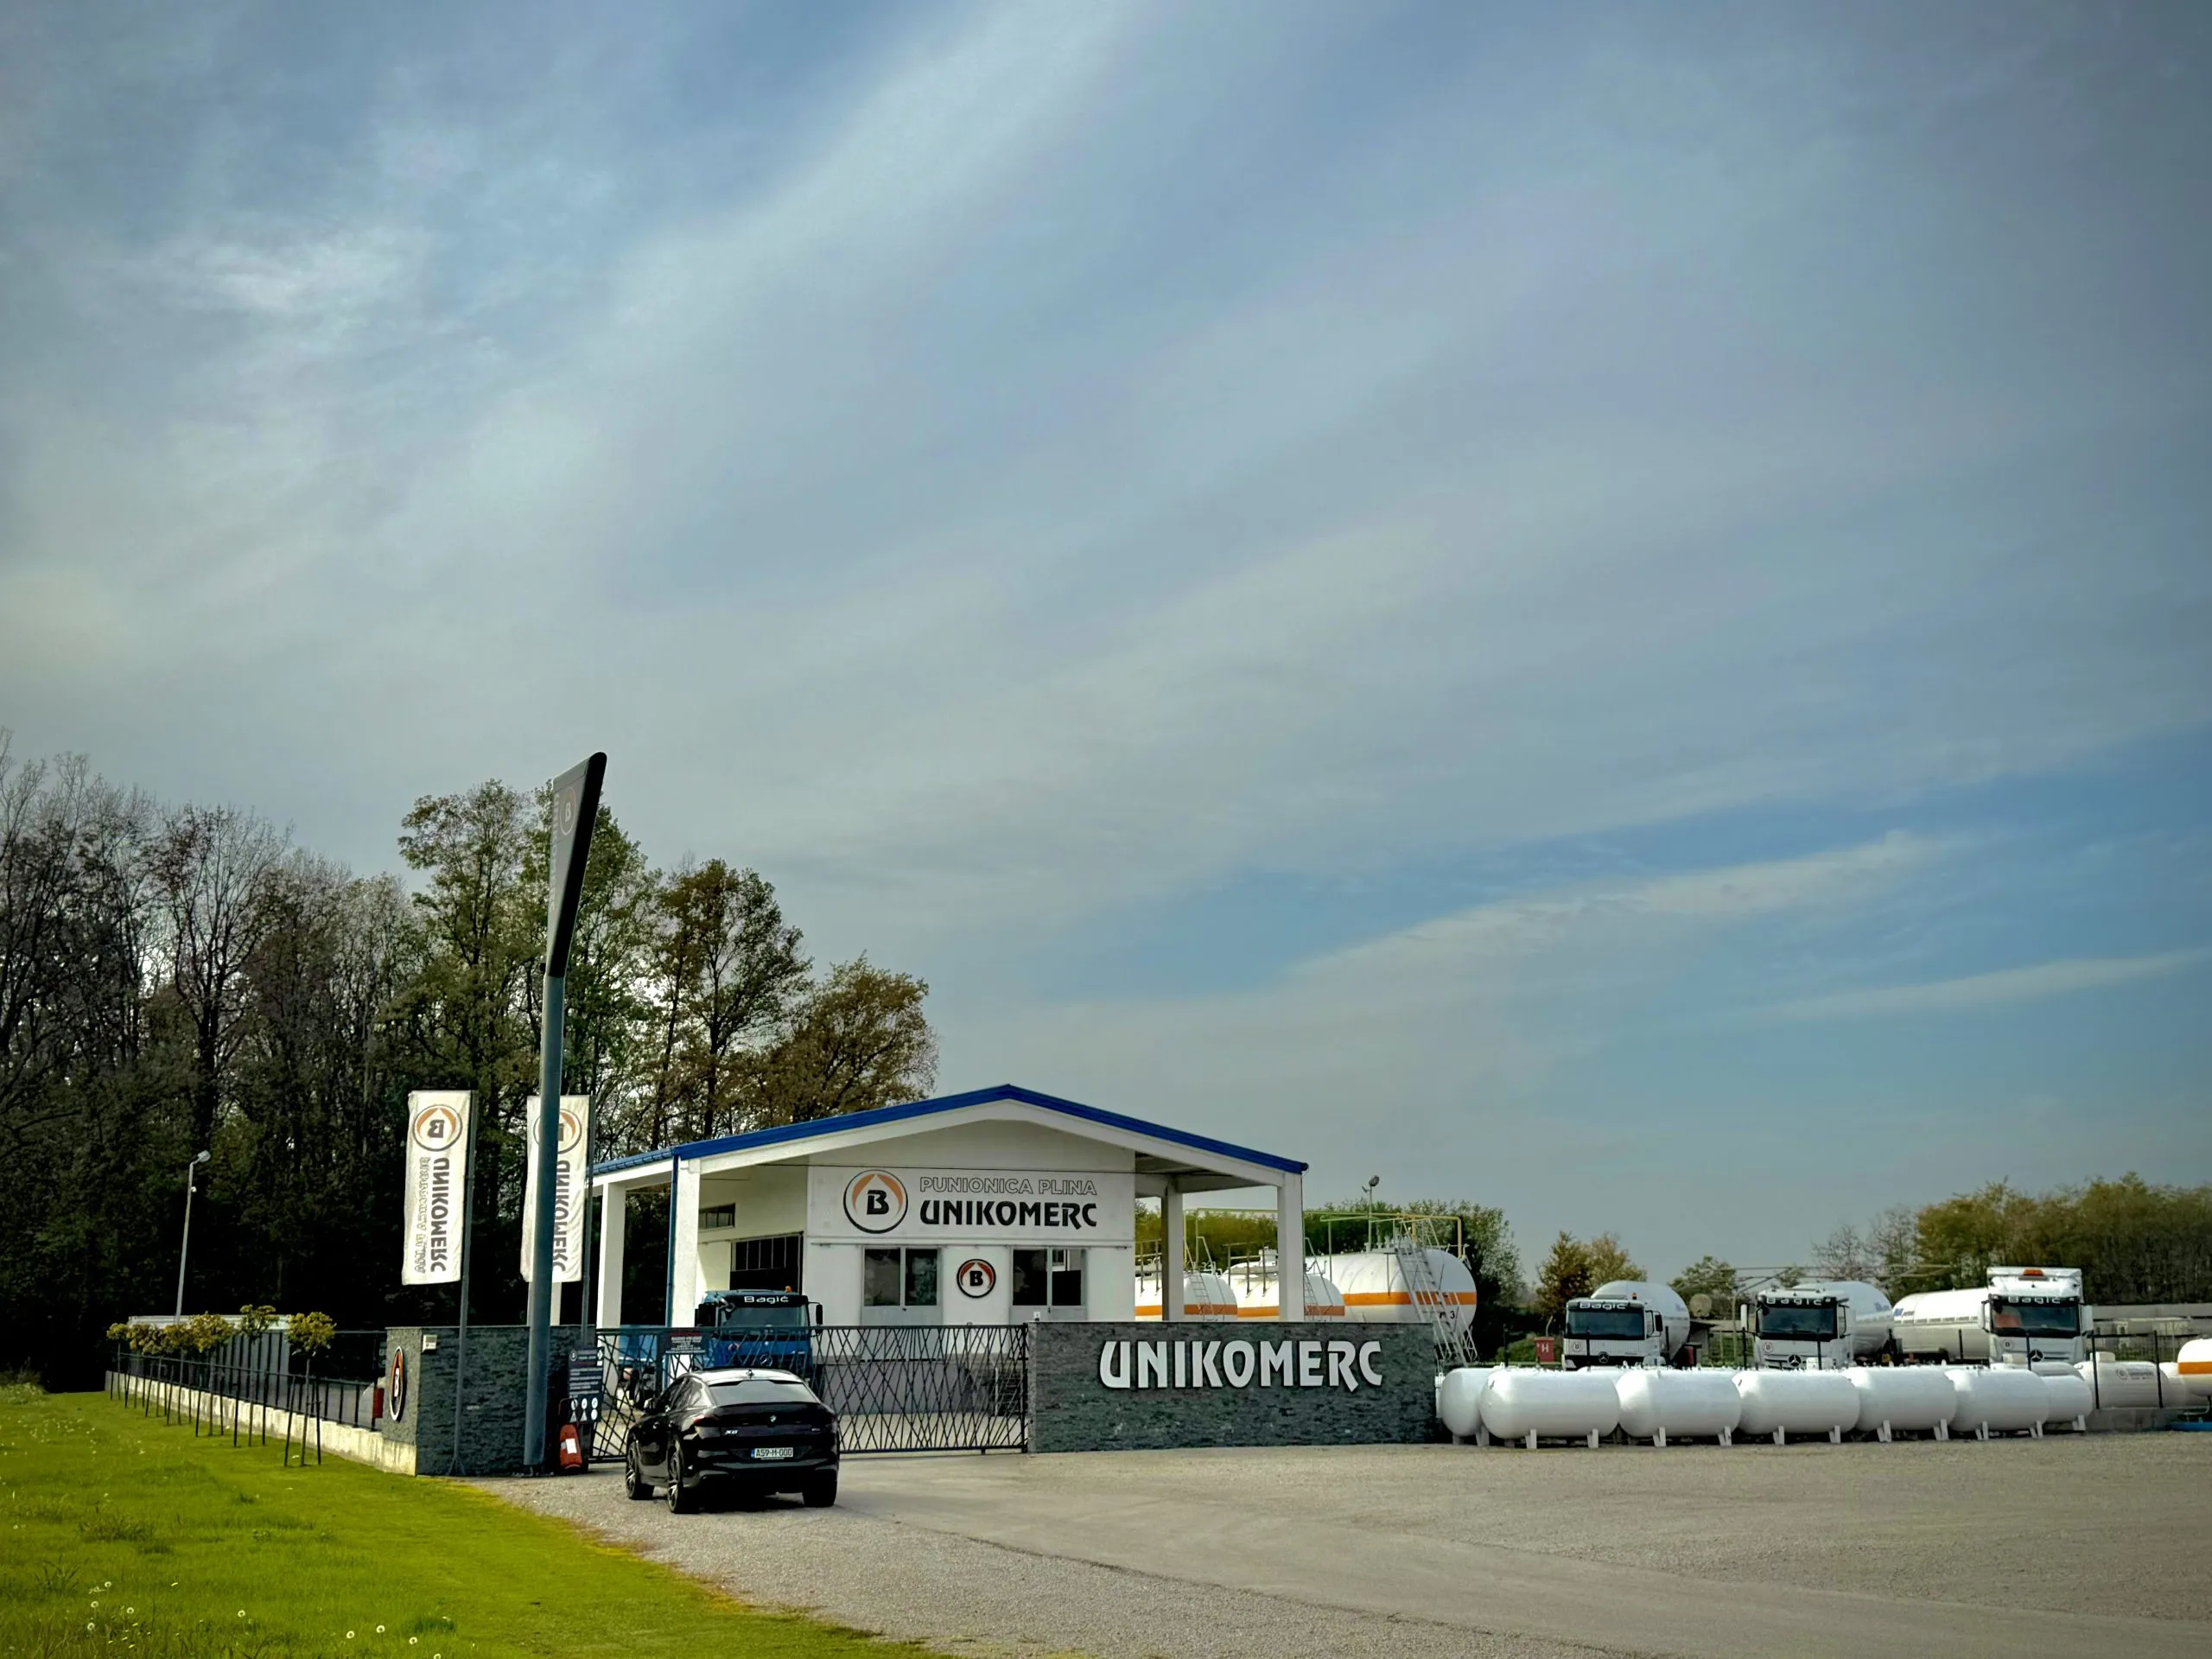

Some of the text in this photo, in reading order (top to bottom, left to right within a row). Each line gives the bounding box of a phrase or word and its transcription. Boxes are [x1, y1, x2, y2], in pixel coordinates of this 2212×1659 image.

[919, 1177, 1097, 1196] PUNIONICA PLINA
[867, 1189, 890, 1215] B
[919, 1199, 1097, 1230] UNIKOMERC
[969, 1270, 984, 1287] B
[1541, 1343, 1549, 1352] H
[1099, 1340, 1382, 1393] UNIKOMERC
